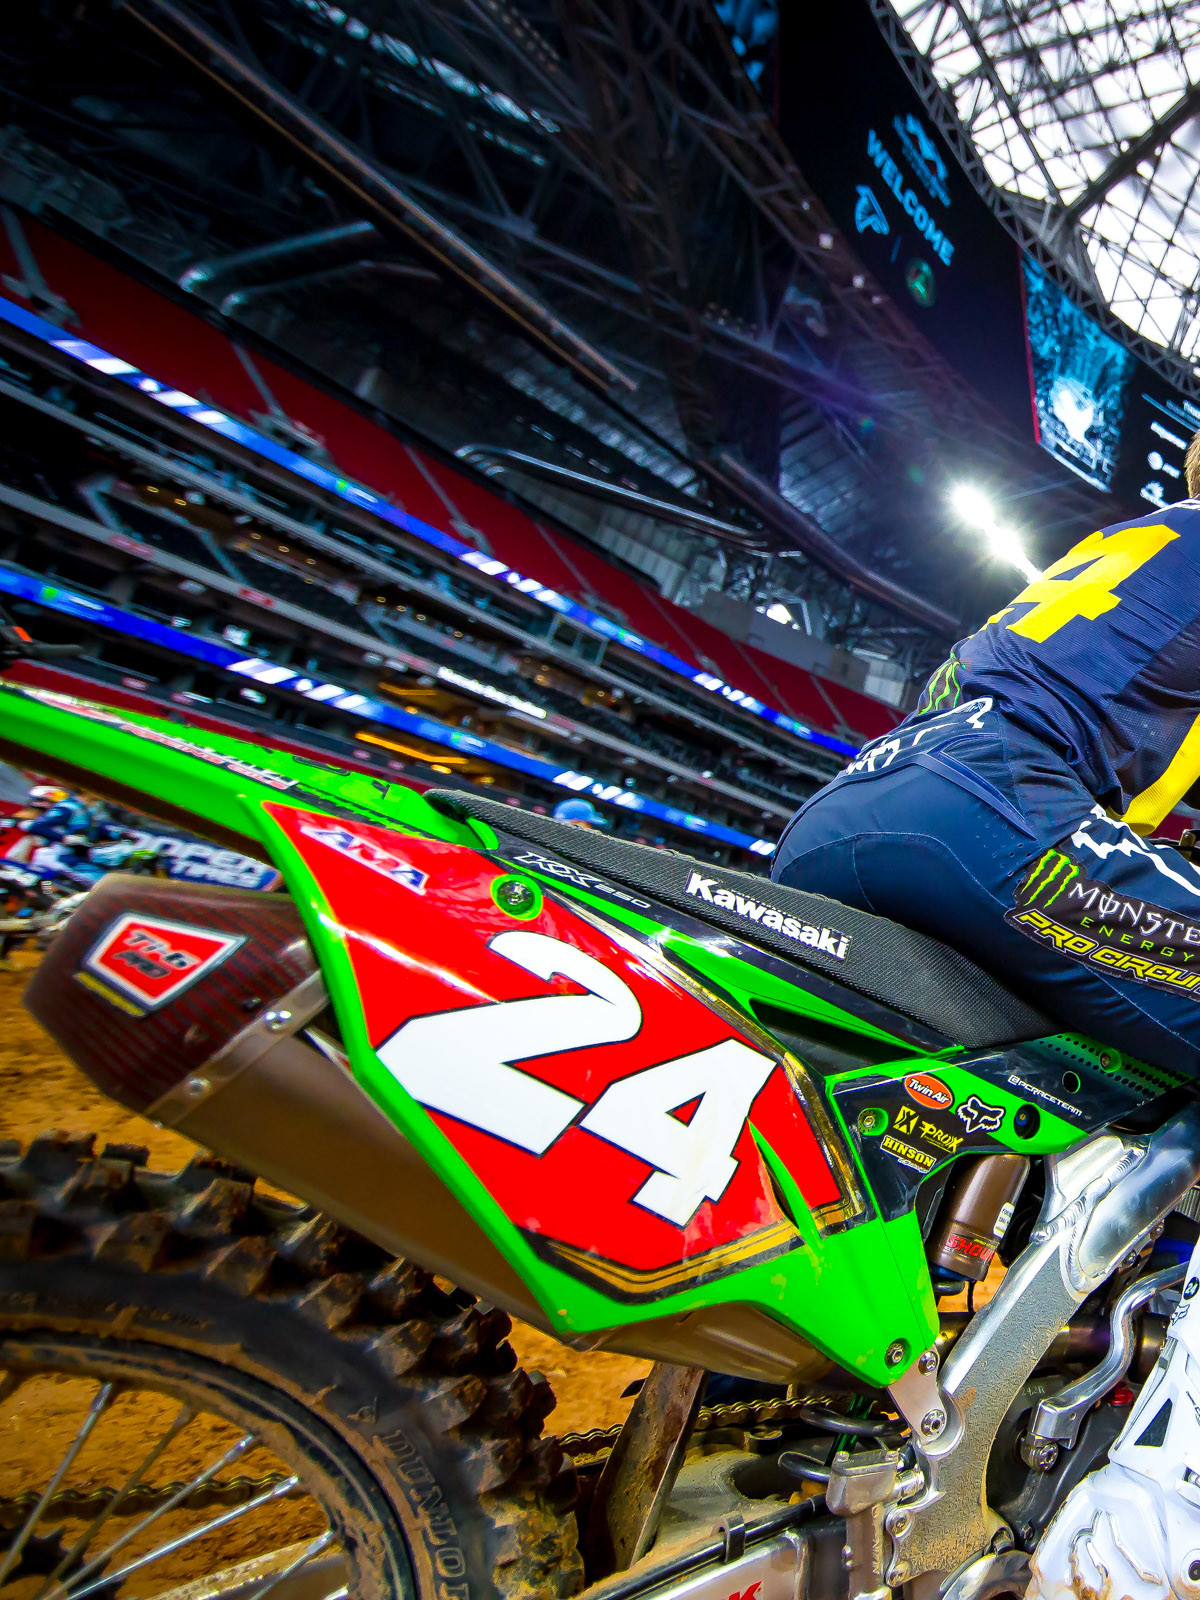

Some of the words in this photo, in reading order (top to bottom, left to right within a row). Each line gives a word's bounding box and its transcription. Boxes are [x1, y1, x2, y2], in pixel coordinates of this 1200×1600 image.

[868, 129, 954, 266] WELCOME
[303, 828, 428, 894] AMA
[686, 871, 851, 960] Kawasaki
[1015, 909, 1098, 955] PRO
[1080, 916, 1195, 962] ENERGY
[375, 929, 778, 1229] 24
[907, 1079, 933, 1098] Twin
[931, 1090, 950, 1105] Air
[1008, 1074, 1083, 1117] @PCRACETEAM
[883, 1136, 936, 1170] HINSON
